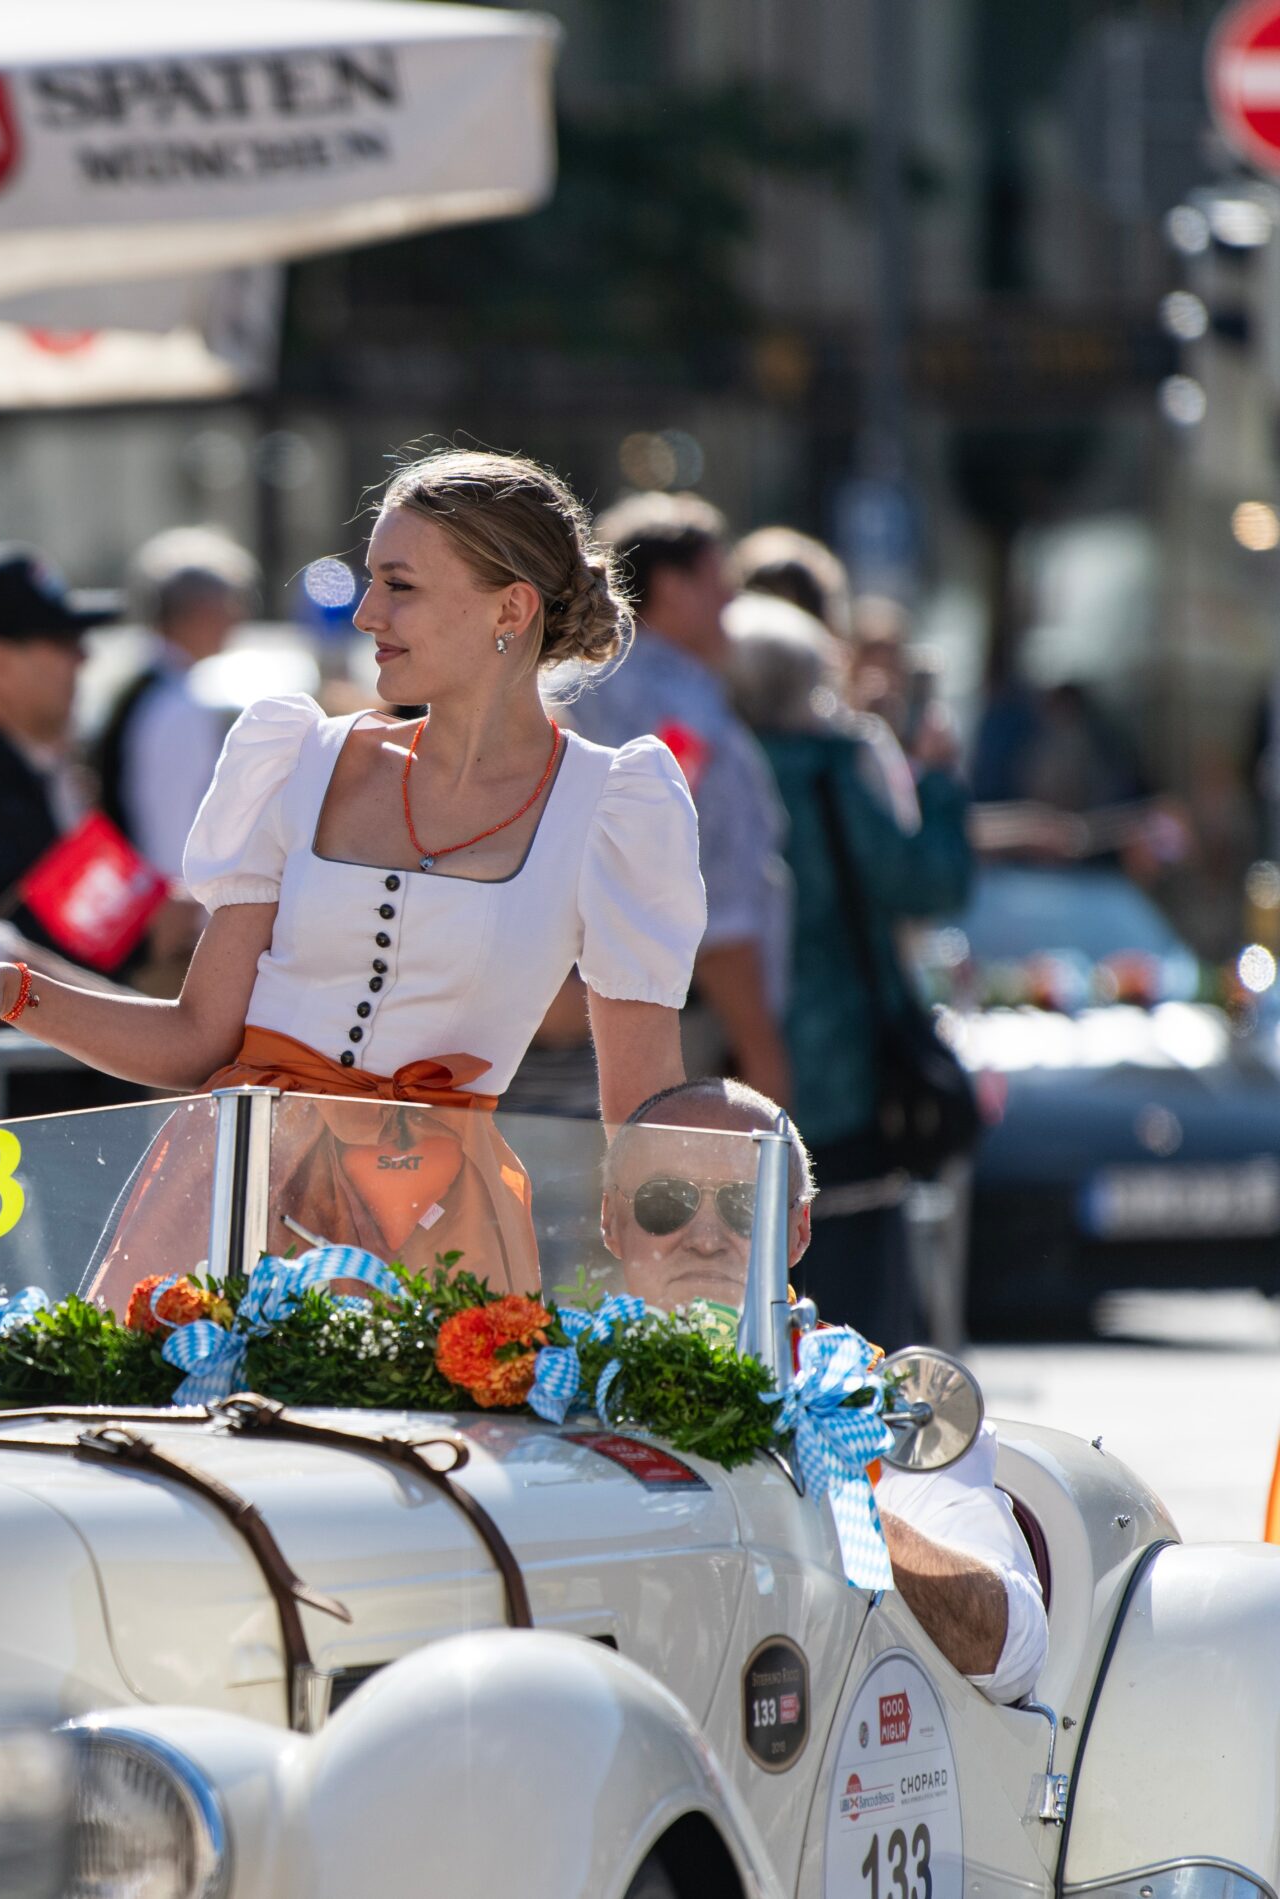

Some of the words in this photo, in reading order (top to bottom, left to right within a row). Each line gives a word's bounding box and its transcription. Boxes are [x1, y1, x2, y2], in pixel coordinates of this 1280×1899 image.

[32, 46, 404, 129] SPATEN
[376, 1154, 424, 1171] SIXT
[753, 1698, 777, 1728] 133
[882, 1698, 904, 1719] 1000
[881, 1720, 906, 1742] MIGLIA
[900, 1769, 948, 1796] CHOPARD
[862, 1822, 933, 1899] 133
